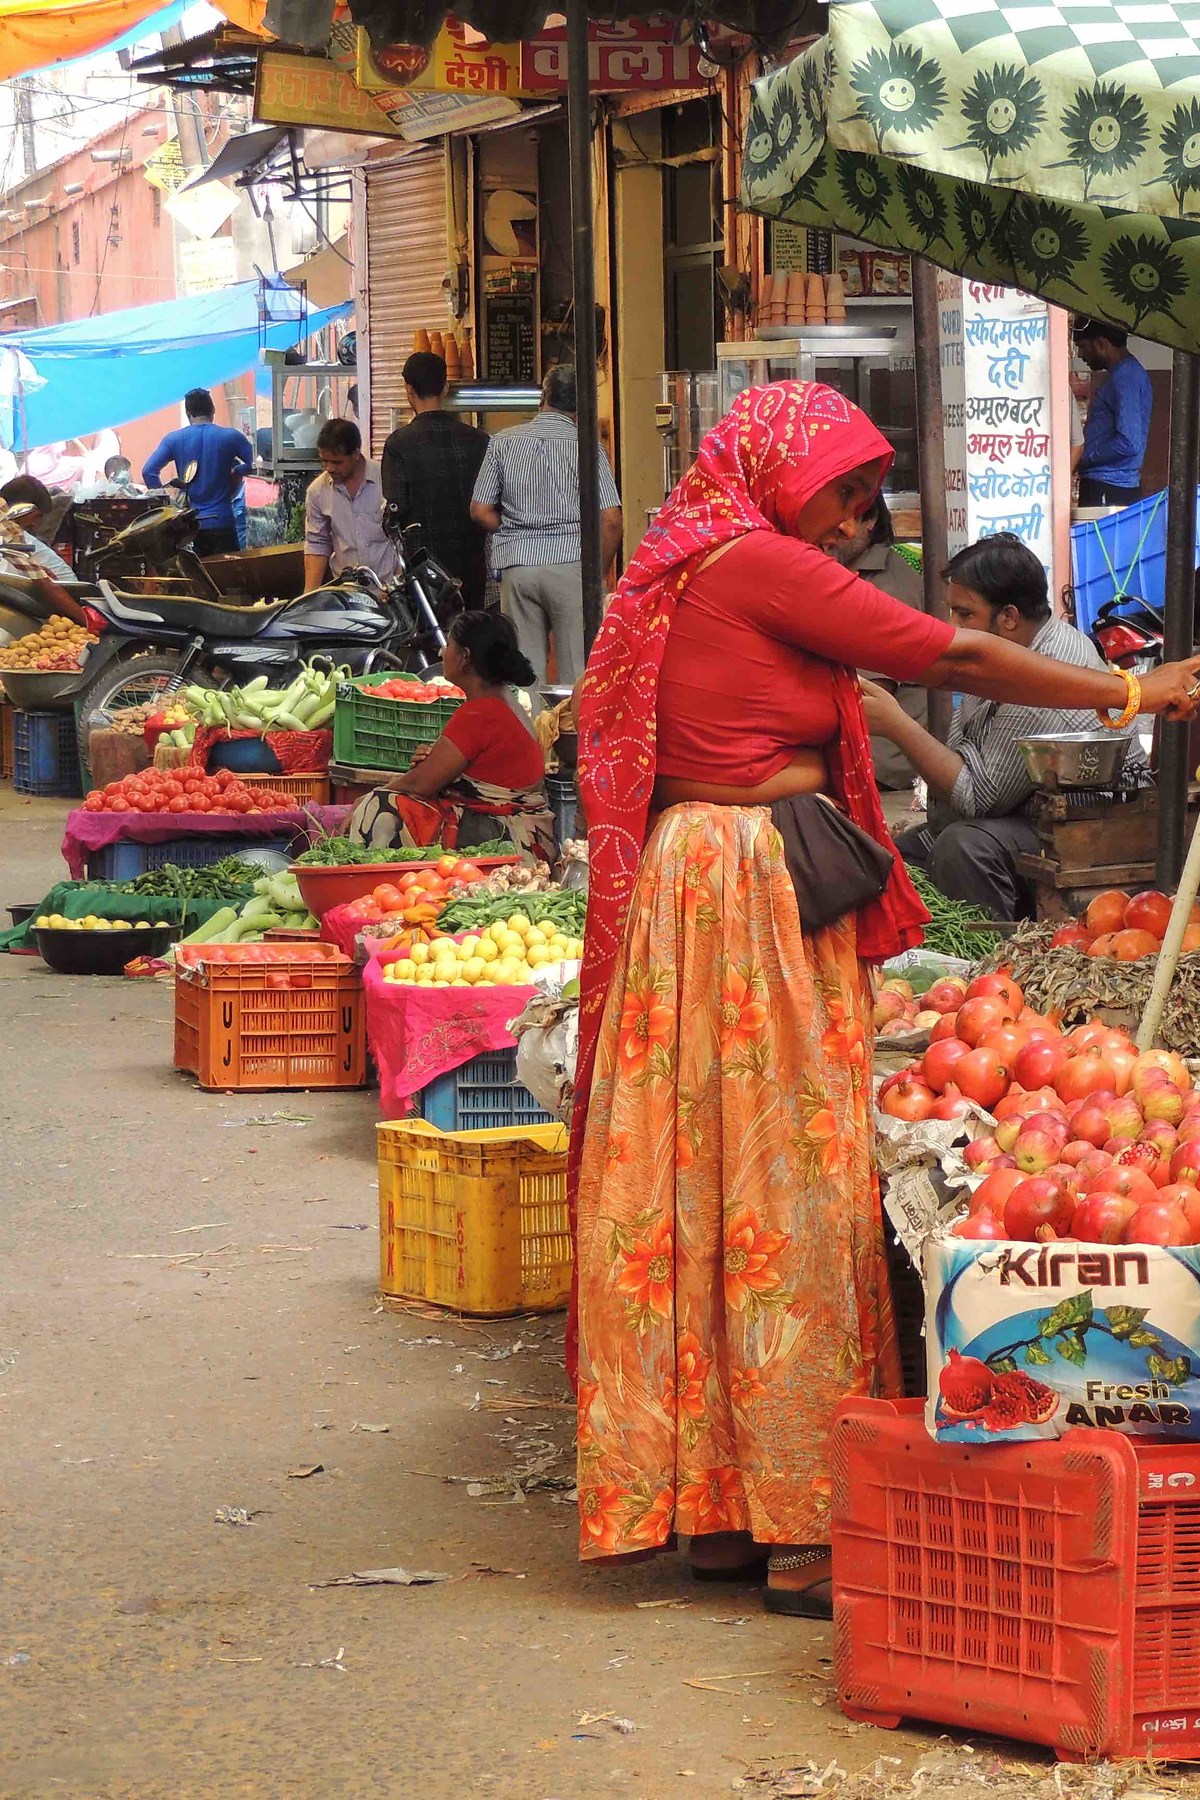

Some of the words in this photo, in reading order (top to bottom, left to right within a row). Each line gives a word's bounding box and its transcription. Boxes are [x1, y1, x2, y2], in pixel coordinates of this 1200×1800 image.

[444, 53, 511, 92] देशी
[987, 347, 1031, 390] दही
[967, 433, 1013, 464] अमूल
[1015, 427, 1051, 458] चीज
[1085, 1378, 1170, 1402] Fresh
[1065, 1402, 1192, 1428] ANAR
[1147, 1472, 1164, 1489] JPR
